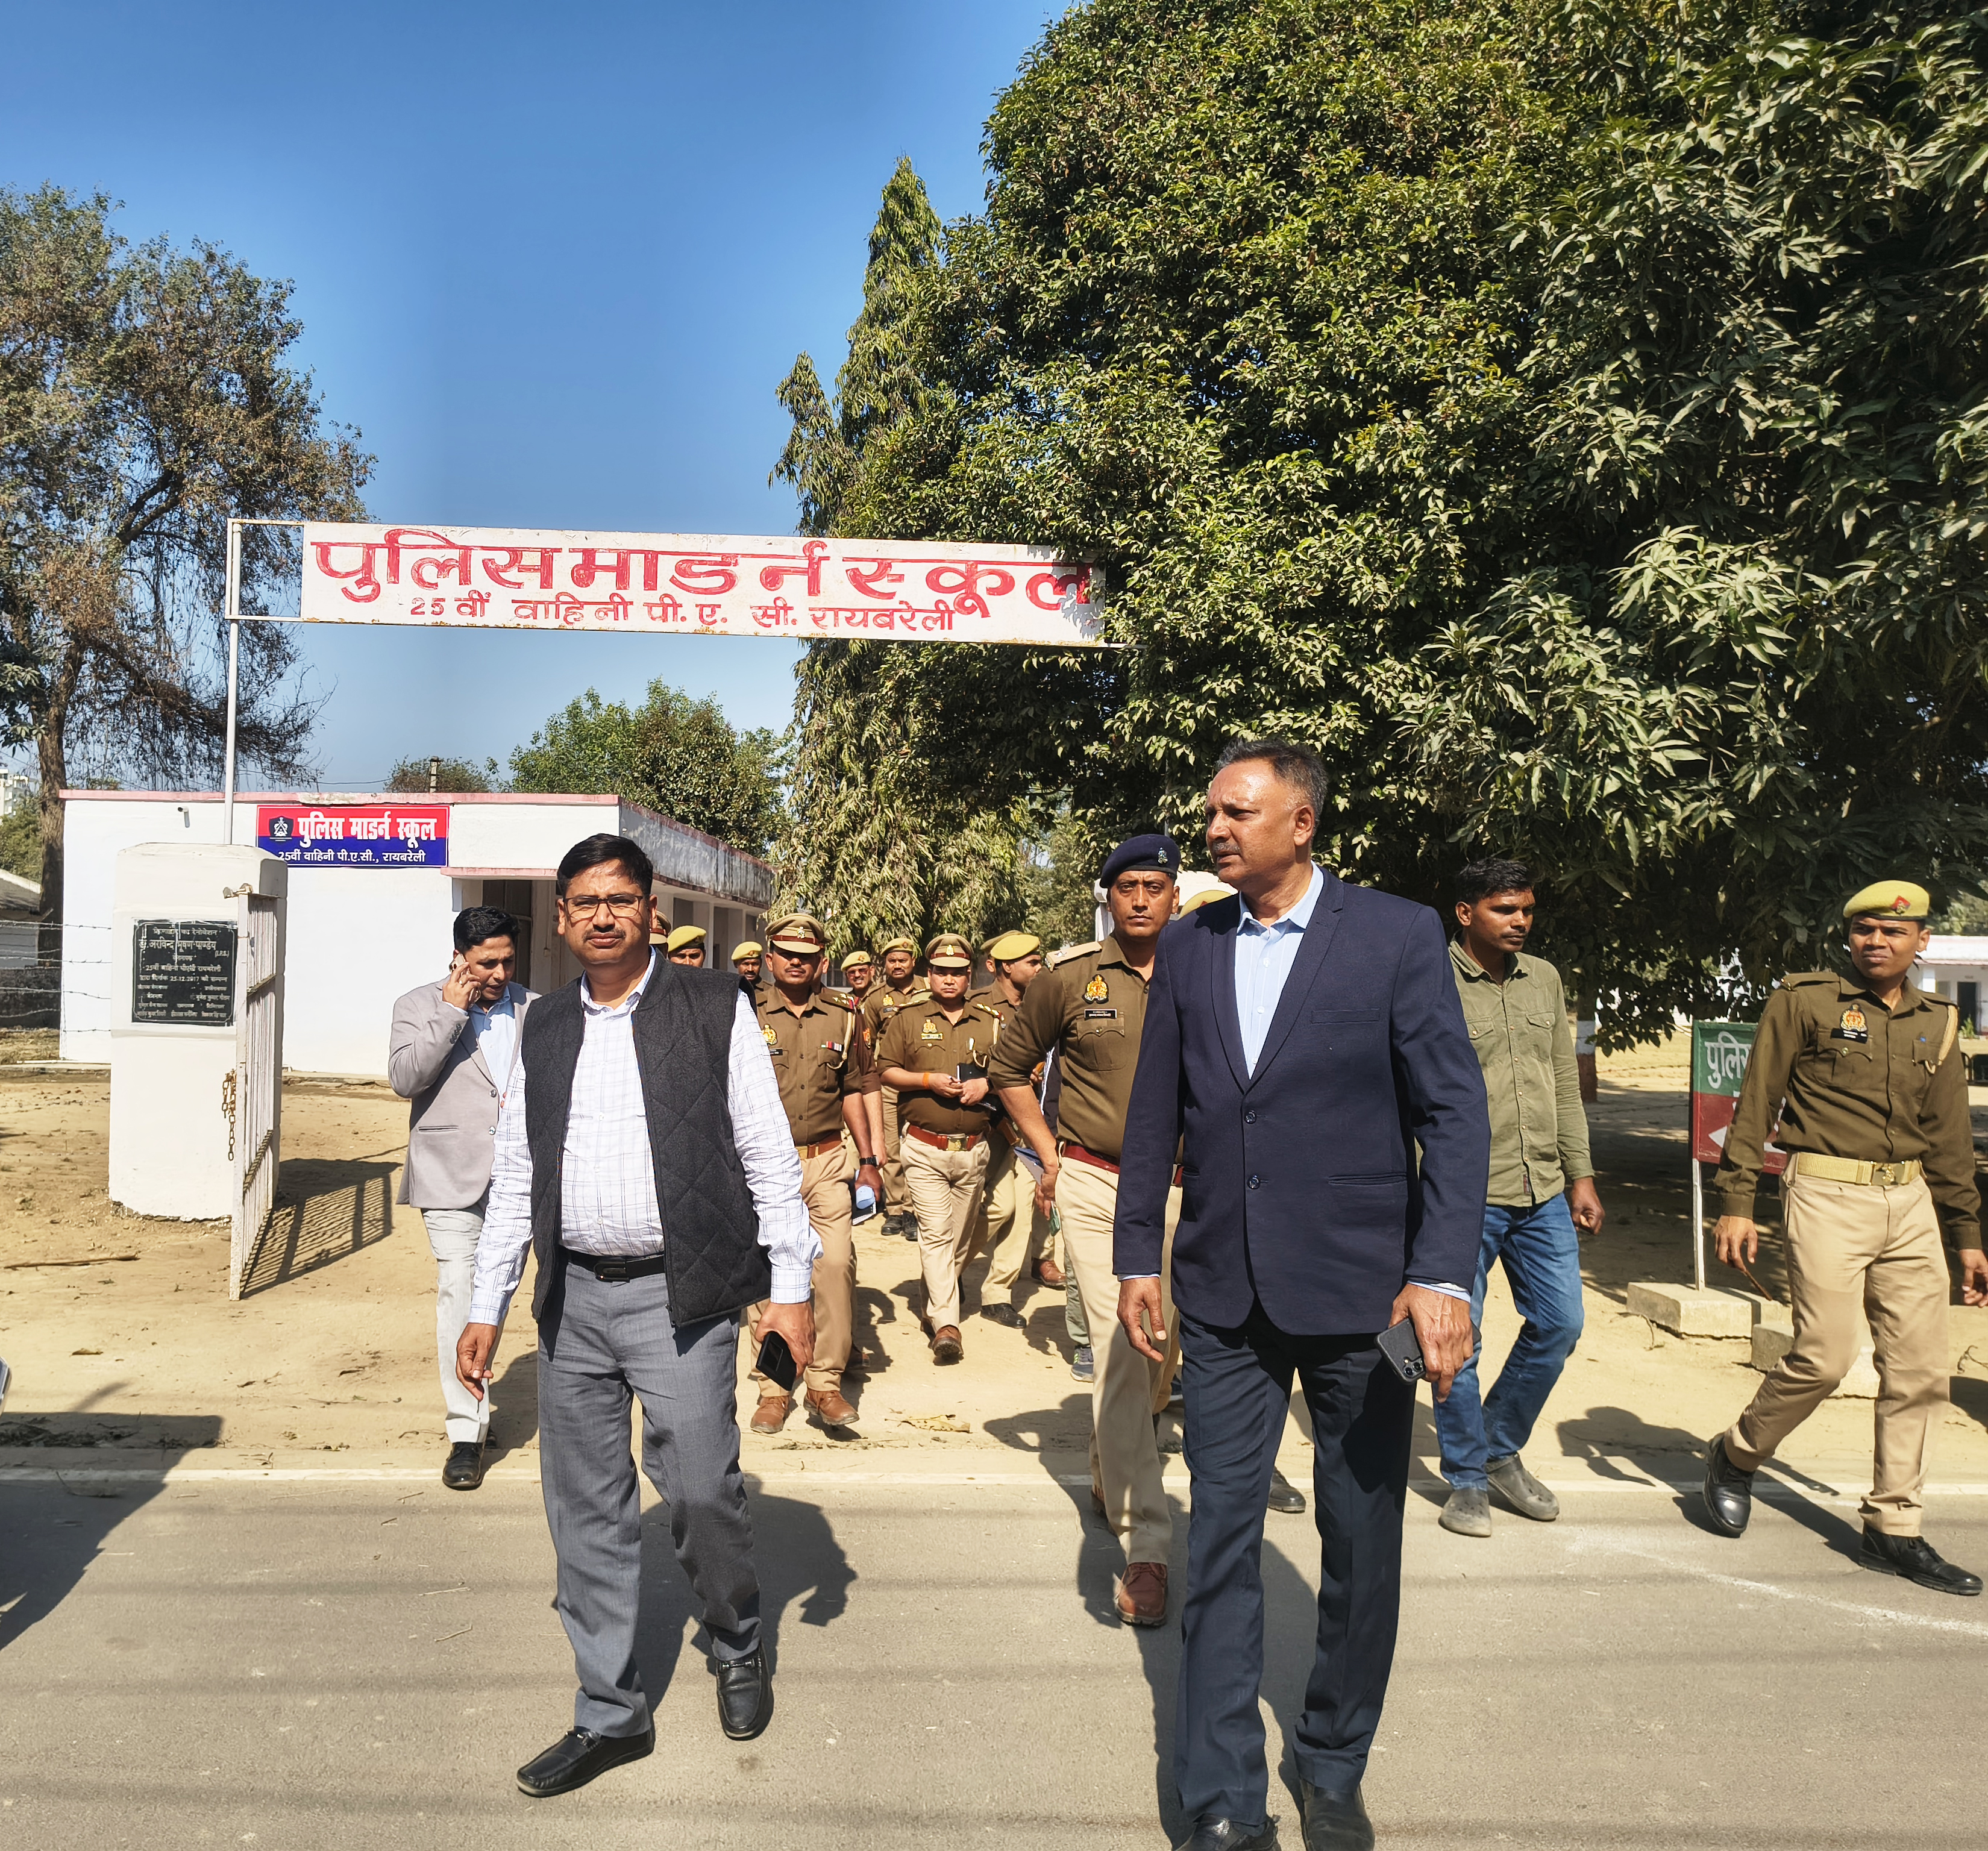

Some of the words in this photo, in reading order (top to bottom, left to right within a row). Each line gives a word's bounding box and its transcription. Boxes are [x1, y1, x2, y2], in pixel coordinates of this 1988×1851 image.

[310, 528, 563, 603] पुलिस
[568, 540, 831, 597] माडर्न
[842, 557, 1094, 618] स्कूल
[511, 591, 634, 626] वाहिनी
[808, 599, 956, 632] रायबरेली
[297, 811, 345, 848] पुलिस
[349, 811, 392, 841] माडर्न
[396, 817, 437, 849] स्कूल
[304, 848, 335, 862] वाहिनी
[383, 849, 426, 863] रायबरेली
